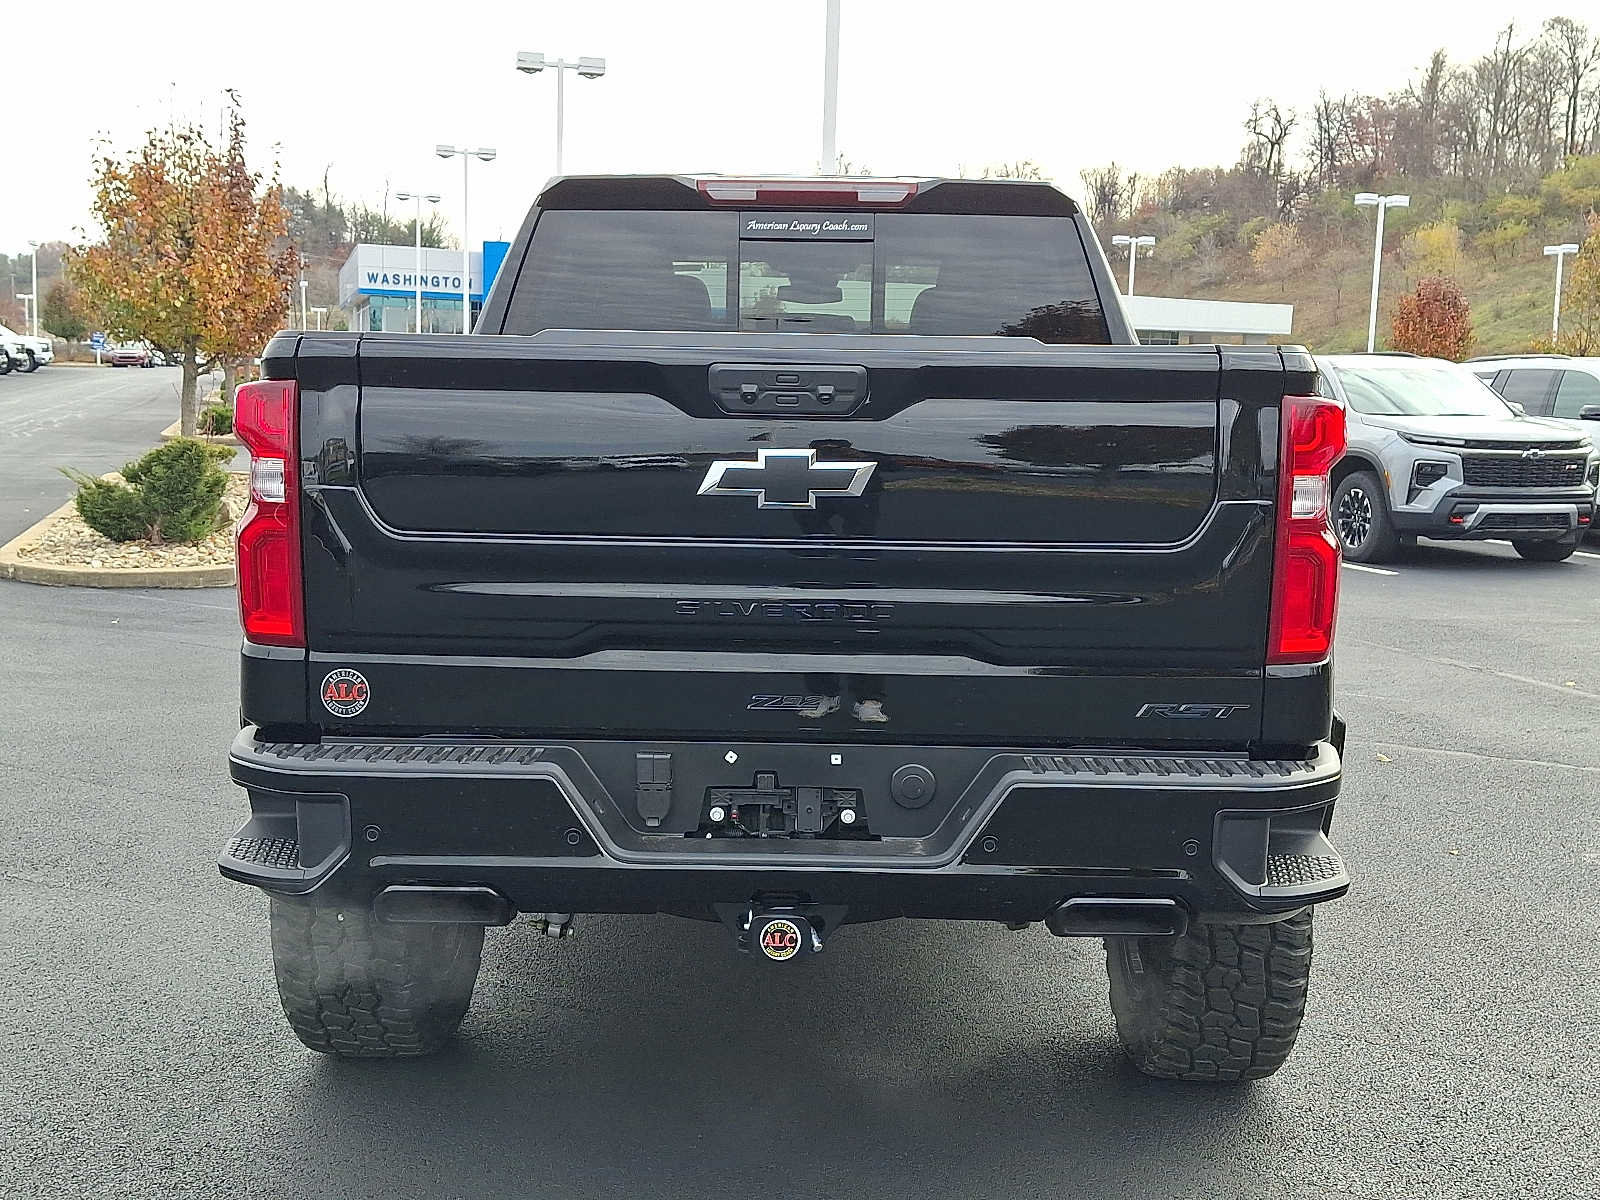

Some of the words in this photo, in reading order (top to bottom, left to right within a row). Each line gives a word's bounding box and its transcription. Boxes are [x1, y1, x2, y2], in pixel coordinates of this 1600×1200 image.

[746, 219, 789, 231] American
[789, 220, 821, 235] Luxury
[822, 219, 868, 231] Coach.com
[324, 683, 367, 701] ALC
[1135, 703, 1250, 719] RST
[763, 932, 797, 947] ALC
